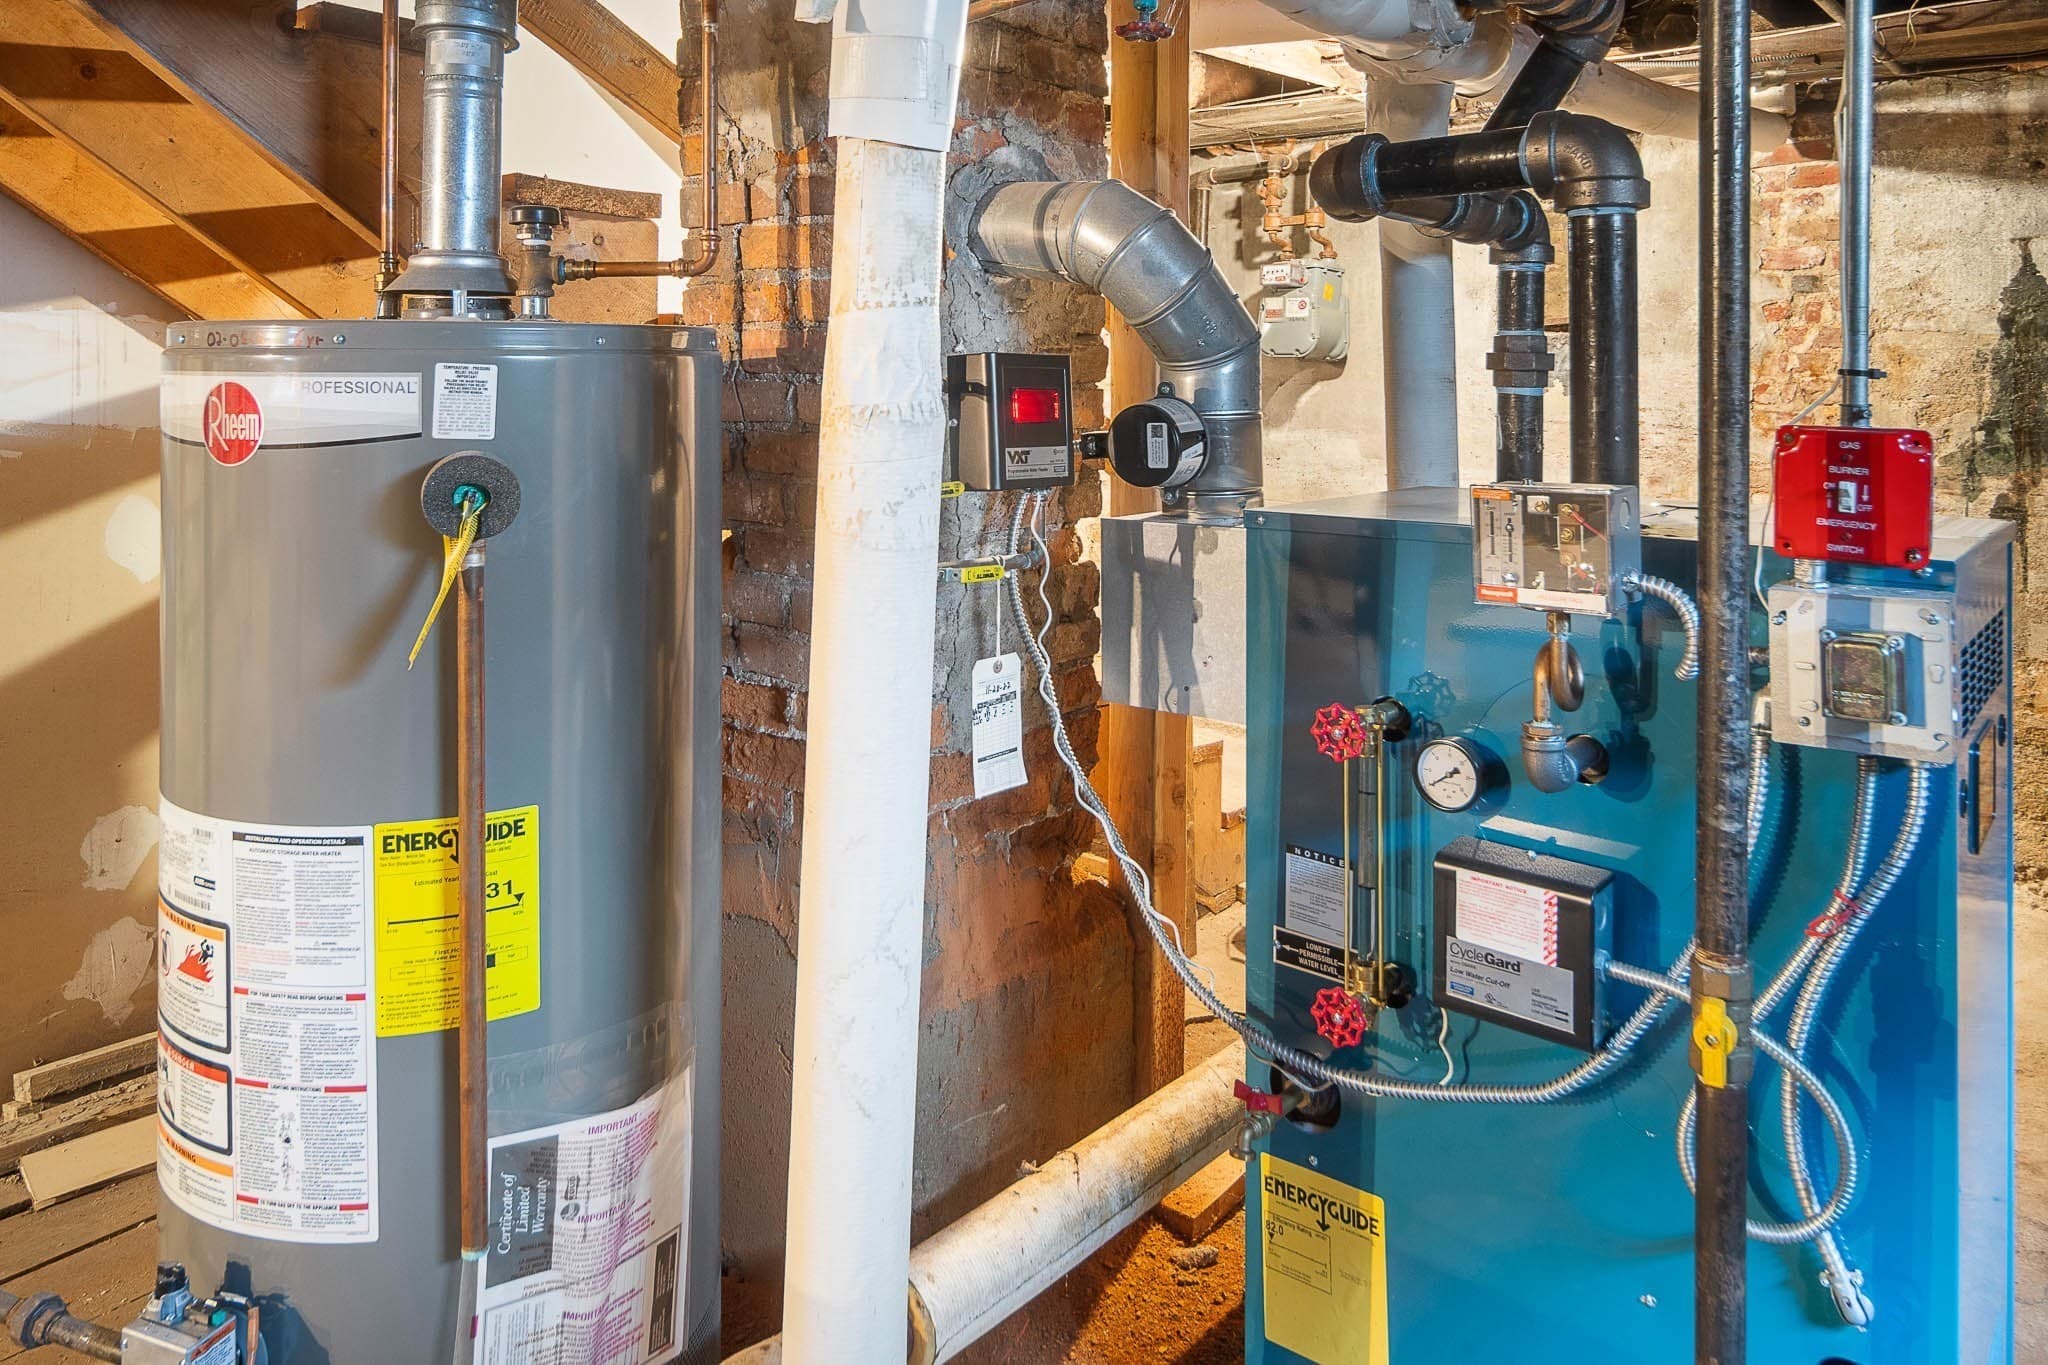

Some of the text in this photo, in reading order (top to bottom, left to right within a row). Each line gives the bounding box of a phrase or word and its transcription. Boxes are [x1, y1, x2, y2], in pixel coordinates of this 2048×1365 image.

[300, 381, 418, 394] ROFESSIONAL
[208, 382, 260, 452] Rheem
[1839, 440, 1861, 450] GAS
[1828, 465, 1869, 476] BURNER
[1822, 481, 1836, 490] ON
[1857, 504, 1873, 512] OFF
[1815, 517, 1878, 531] EMERGENCY
[1826, 543, 1865, 555] SWITCH
[322, 838, 346, 846] DETAILS
[1294, 847, 1345, 867] NOTICE
[1298, 947, 1339, 967] PERMISSIBLE
[1305, 941, 1331, 956] LOWEST
[1450, 942, 1521, 973] CycleGard
[1298, 957, 1339, 976] WATER LEVEL
[1450, 966, 1464, 975] Low
[1465, 970, 1484, 982] Water
[588, 1112, 639, 1136] IMPORTANT
[497, 1170, 517, 1255] Certificate of
[515, 1186, 530, 1233] Limited
[531, 1176, 551, 1234] Warranty
[1264, 1175, 1380, 1238] ENERGYGUIDE
[1265, 1219, 1284, 1236] 82.0
